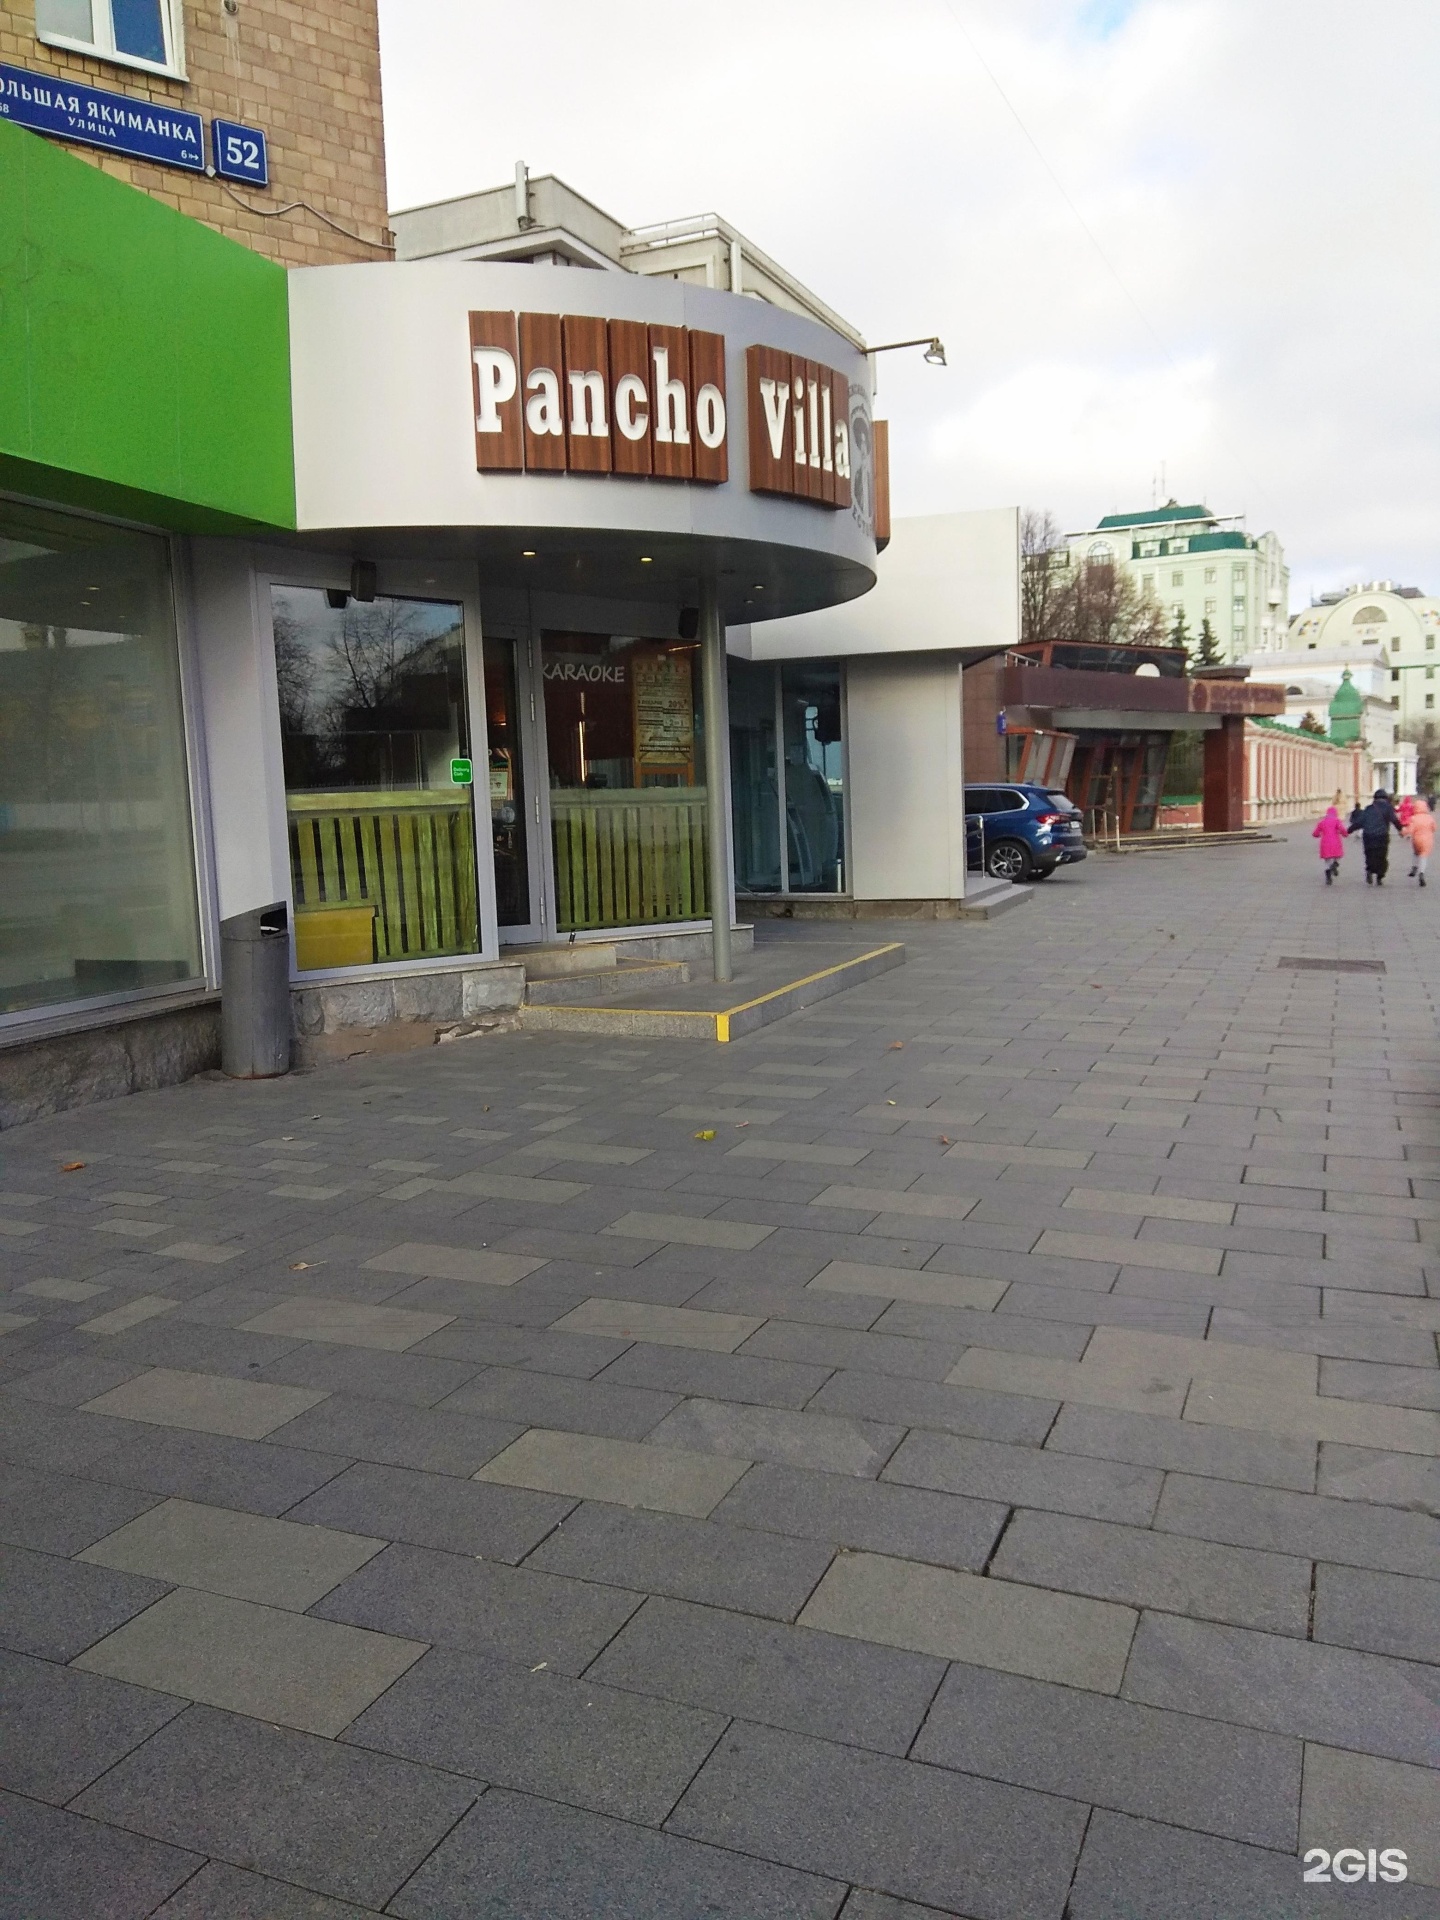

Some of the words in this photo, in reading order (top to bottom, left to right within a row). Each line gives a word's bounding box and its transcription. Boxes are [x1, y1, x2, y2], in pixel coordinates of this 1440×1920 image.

[67, 116, 117, 138] УЛИЦА
[87, 101, 197, 143] ЯКИМАНКА
[181, 149, 188, 159] 6
[226, 137, 260, 170] 52
[473, 345, 727, 449] Pancho
[759, 375, 851, 480] Villa
[542, 662, 625, 682] KARAOKE
